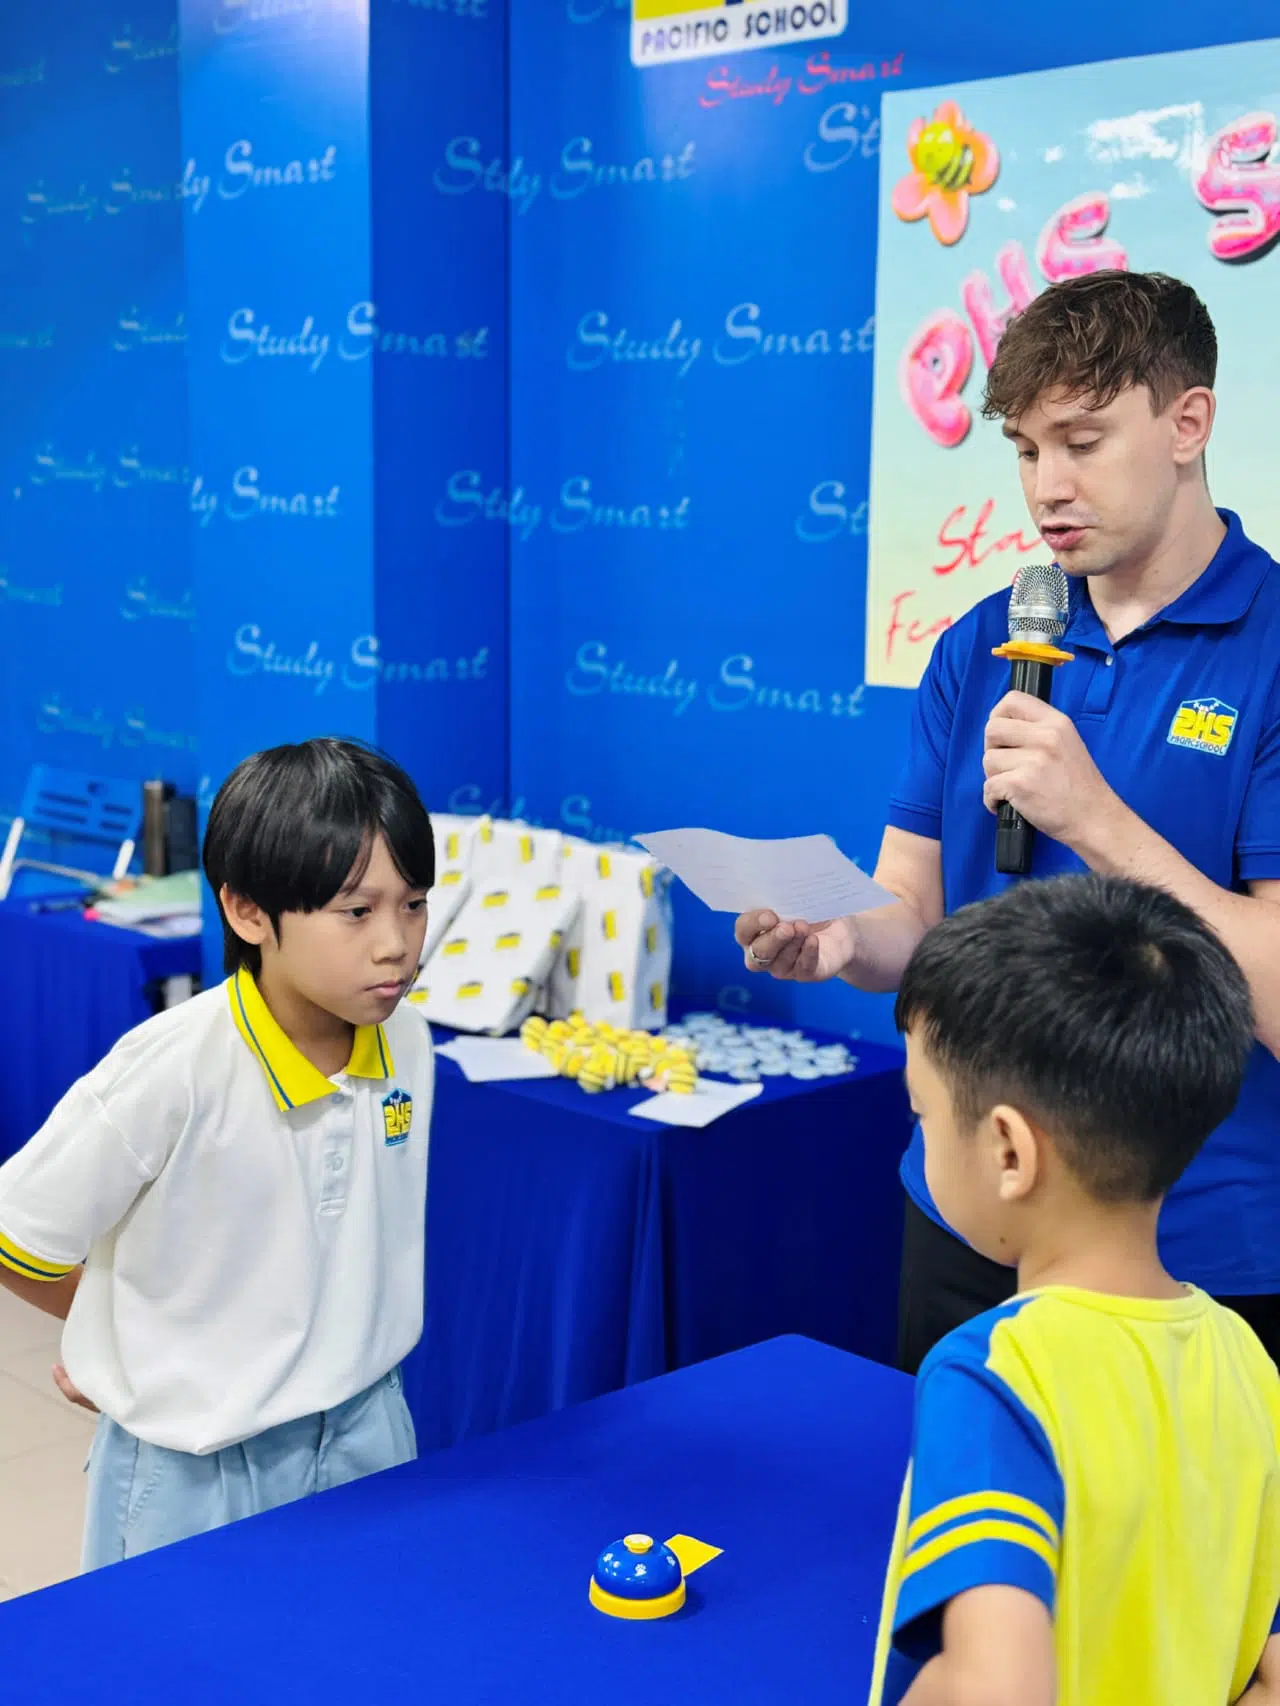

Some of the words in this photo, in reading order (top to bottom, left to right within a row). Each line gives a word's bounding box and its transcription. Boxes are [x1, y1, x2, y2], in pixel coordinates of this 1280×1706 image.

[641, 18, 729, 56] PACIFIC
[745, 0, 836, 39] SCHOOL
[699, 66, 792, 108] Study
[798, 52, 904, 95] Smart
[218, 139, 337, 199] Smart
[549, 137, 696, 199] Smart
[221, 308, 329, 372] Study
[338, 301, 488, 361] Smart
[567, 311, 702, 380] Study
[713, 303, 875, 365] Smart
[225, 466, 340, 521] Smart
[549, 477, 690, 533] Smart
[227, 624, 335, 695] Study
[341, 635, 489, 690] Smart
[566, 641, 698, 717] Study
[707, 654, 865, 718] Smart
